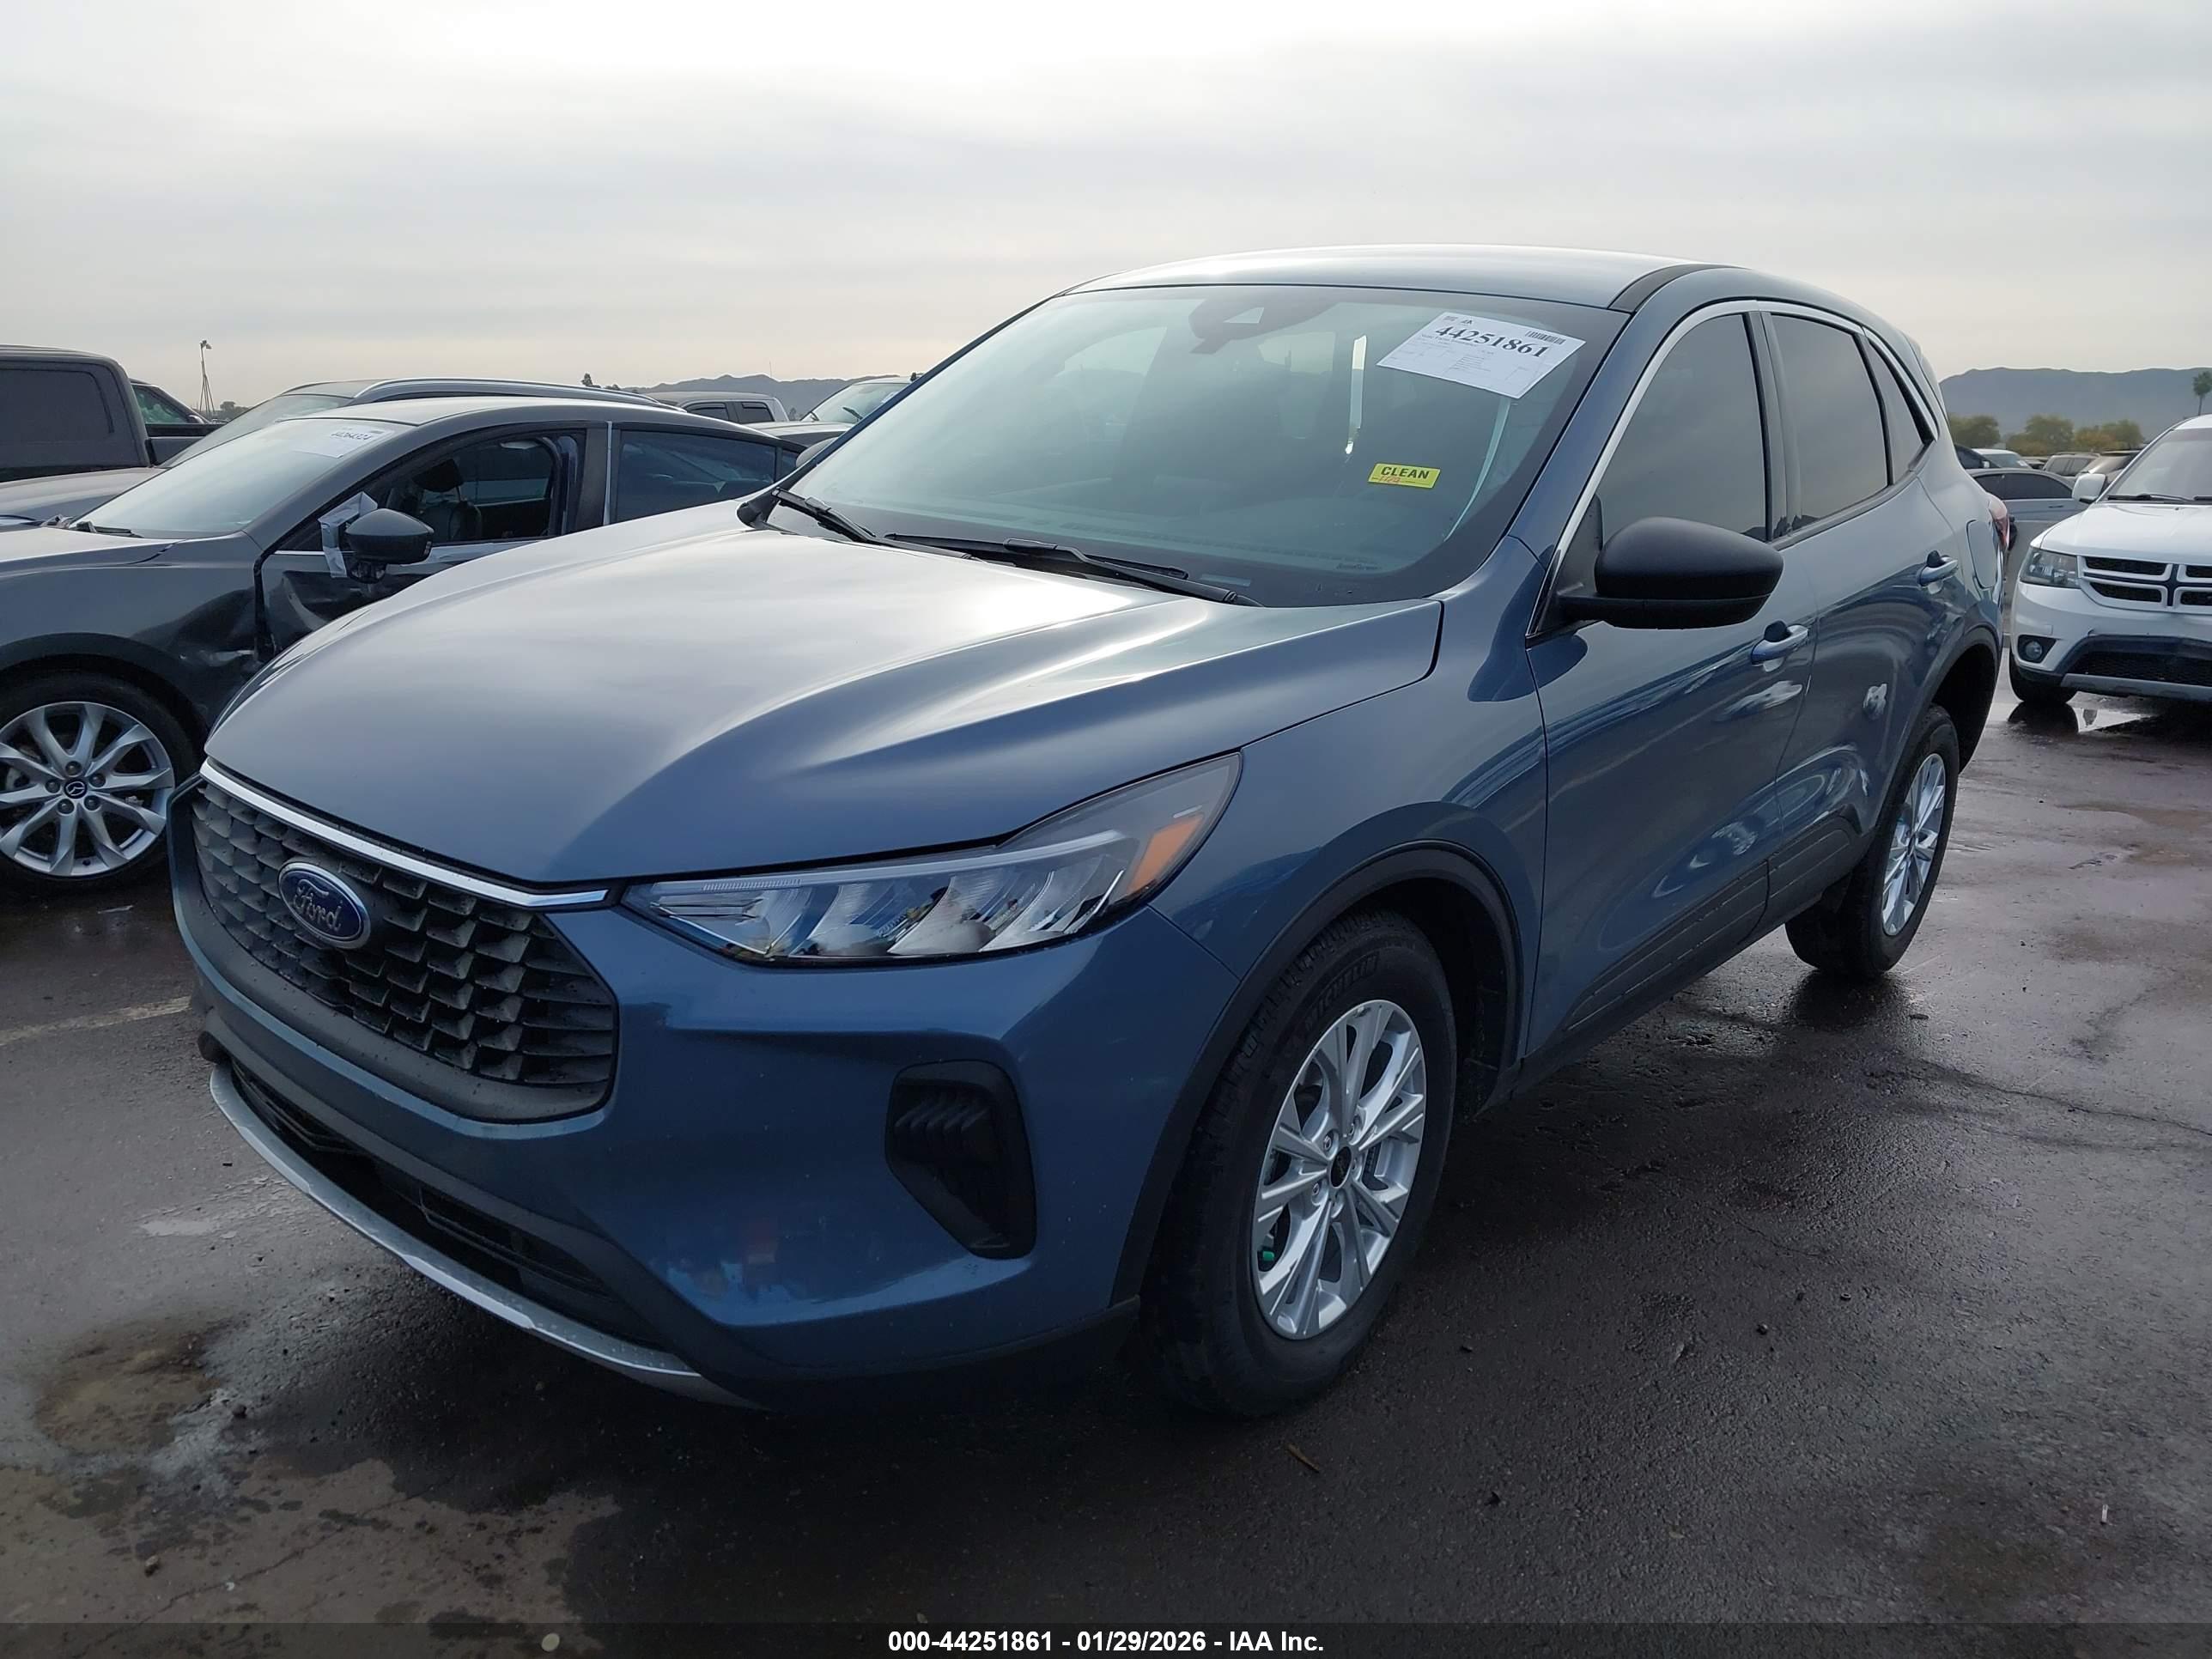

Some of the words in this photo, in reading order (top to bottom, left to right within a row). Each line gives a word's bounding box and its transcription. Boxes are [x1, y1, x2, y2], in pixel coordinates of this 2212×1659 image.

[1435, 325, 1550, 359] 44251861
[1380, 466, 1430, 479] CLEAN
[293, 878, 343, 932] Ford
